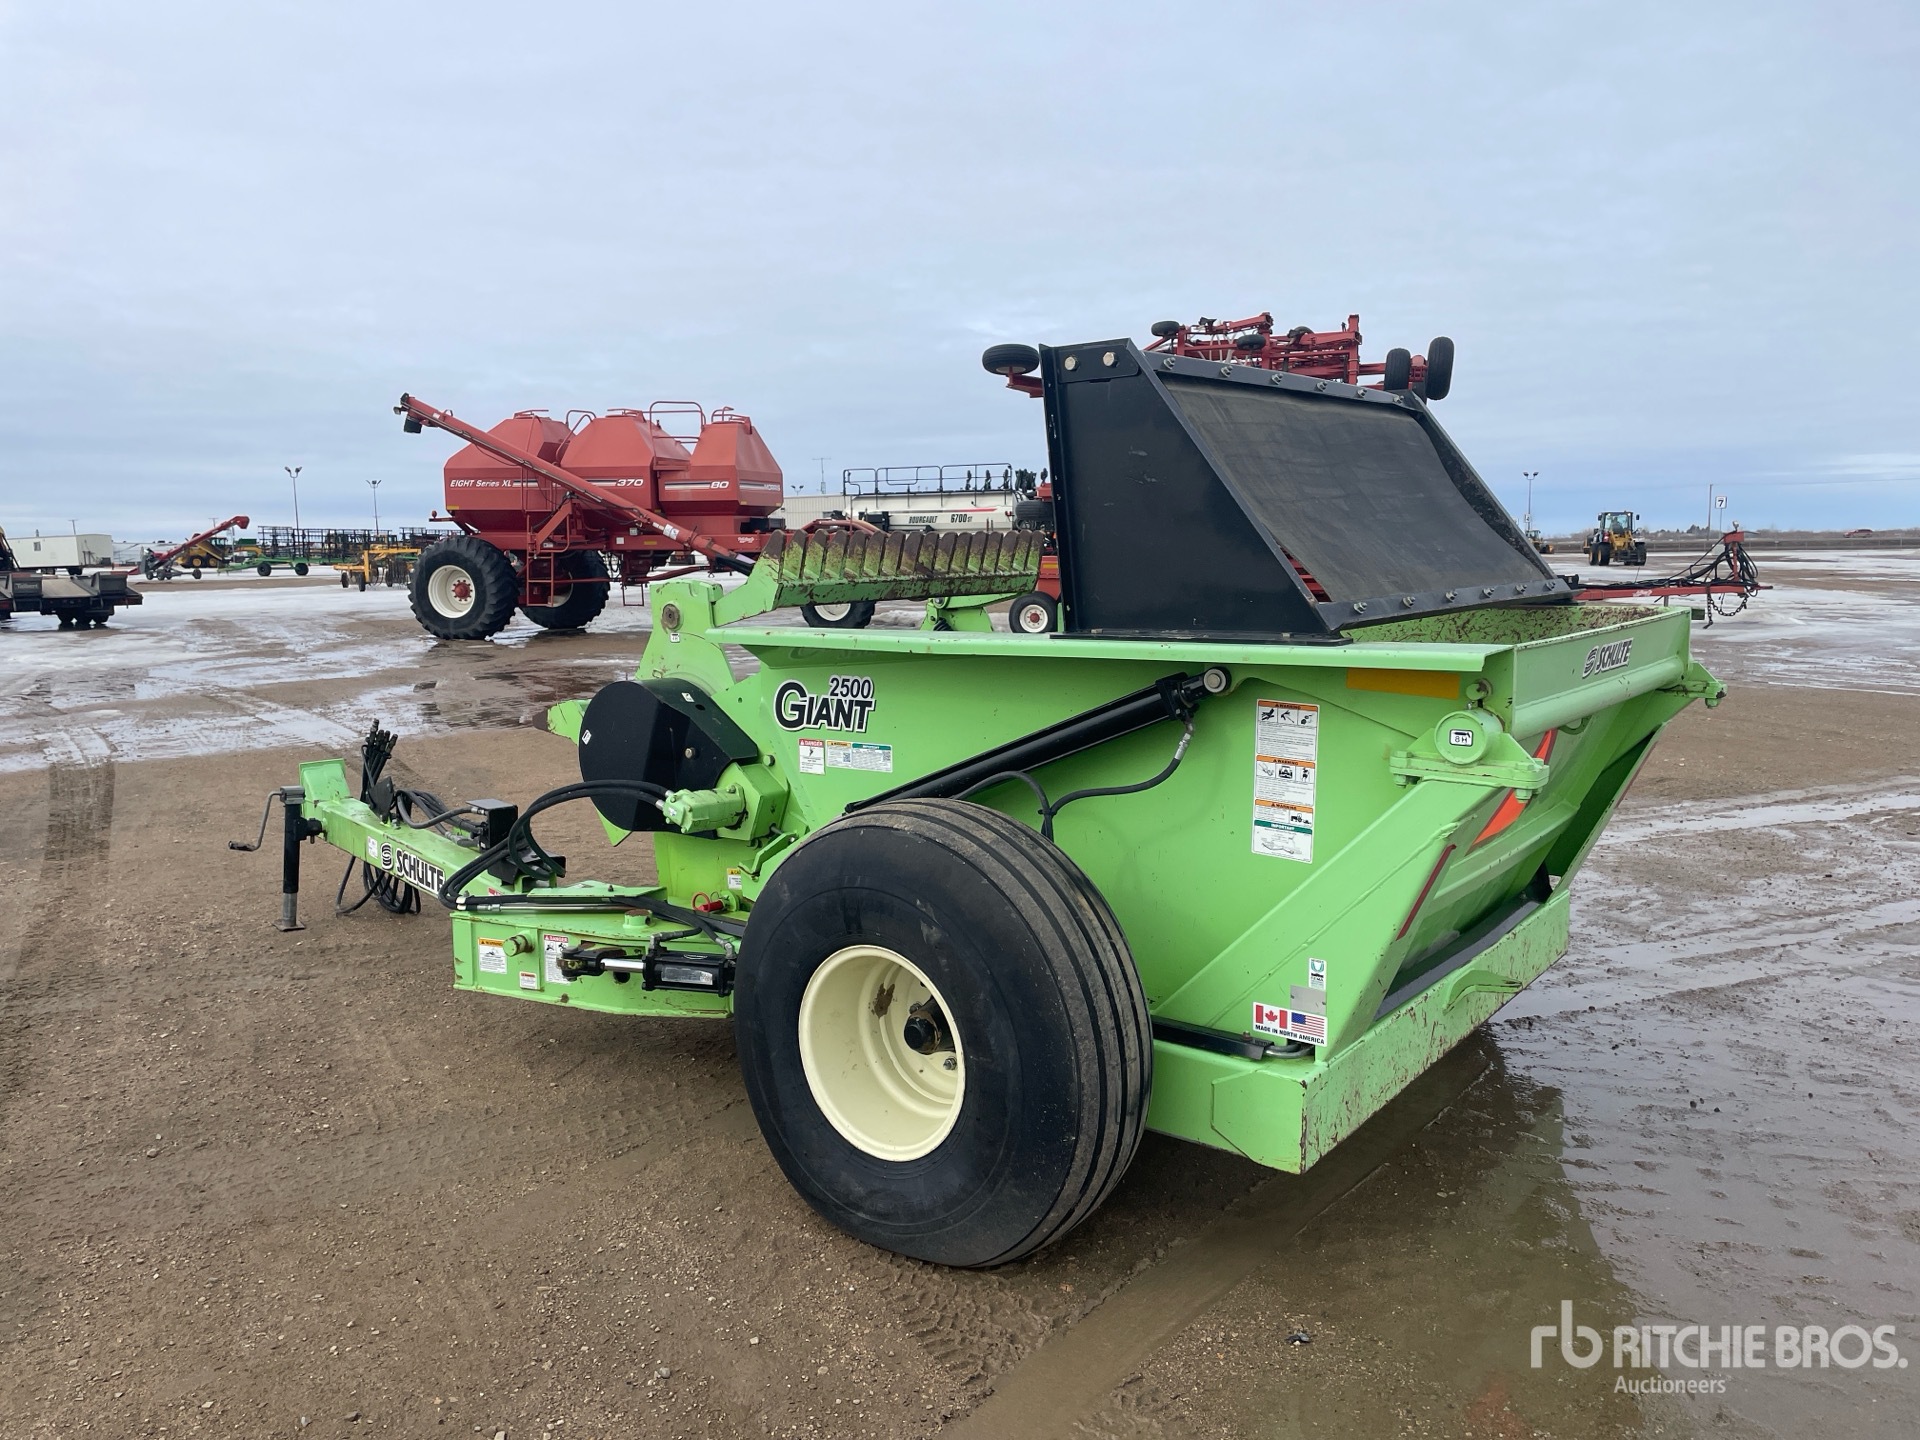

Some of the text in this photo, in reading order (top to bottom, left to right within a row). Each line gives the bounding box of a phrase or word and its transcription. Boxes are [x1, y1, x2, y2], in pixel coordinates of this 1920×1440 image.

[450, 479, 513, 488] EIGHT Series XL
[615, 478, 643, 487] 370
[710, 480, 729, 489] 80
[909, 515, 938, 524] BOURGAULT
[1595, 639, 1633, 672] SCHULTE
[829, 677, 872, 699] 2500
[1255, 1024, 1271, 1033] MADE
[1279, 1030, 1298, 1038] NORTH
[1298, 1034, 1325, 1045] AMERICA
